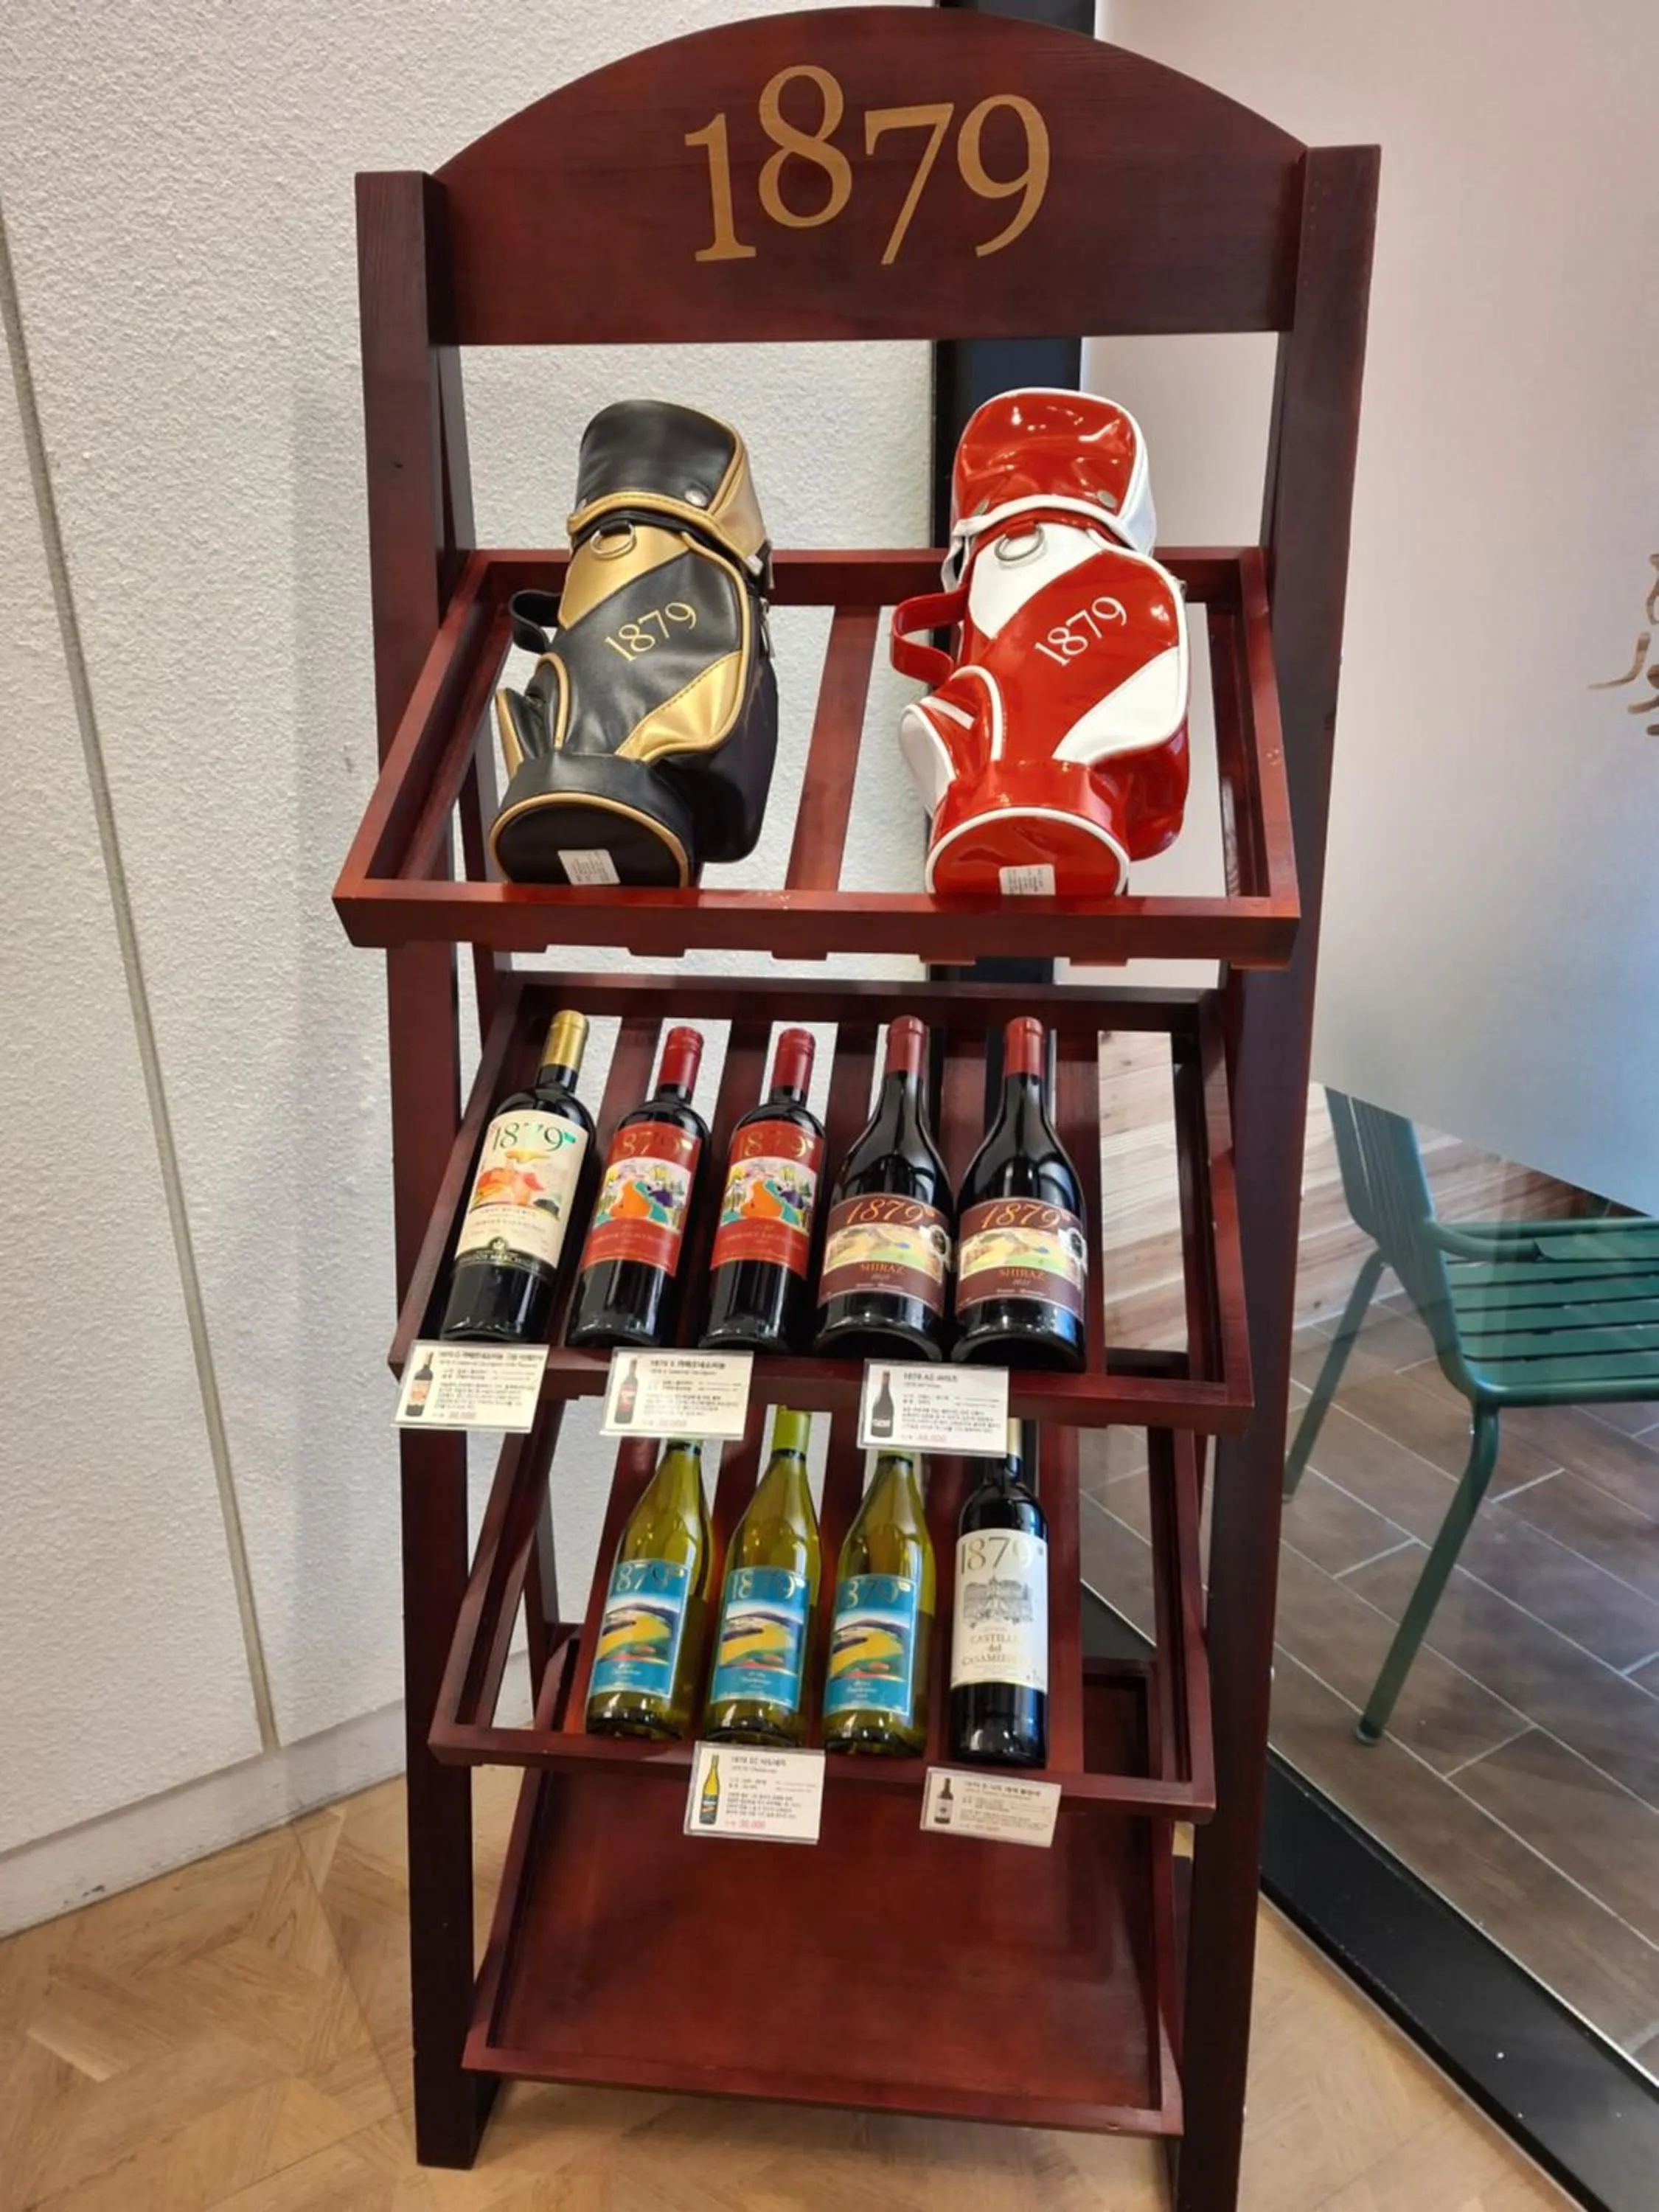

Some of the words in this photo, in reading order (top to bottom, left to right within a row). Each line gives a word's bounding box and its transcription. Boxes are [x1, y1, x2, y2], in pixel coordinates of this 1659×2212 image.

[684, 65, 1050, 265] 1879
[605, 601, 697, 662] 1879
[1034, 596, 1127, 666] 1879
[613, 1130, 681, 1156] 879
[739, 1130, 807, 1157] 189
[847, 1199, 923, 1224] 1879
[981, 1203, 1062, 1229] 1879
[860, 1262, 907, 1274] SHIRAZ
[998, 1267, 1045, 1281] SHIRAZ
[961, 1537, 1032, 1574] 1879
[611, 1562, 669, 1592] 879
[732, 1571, 795, 1599] 189
[839, 1579, 899, 1608] 879
